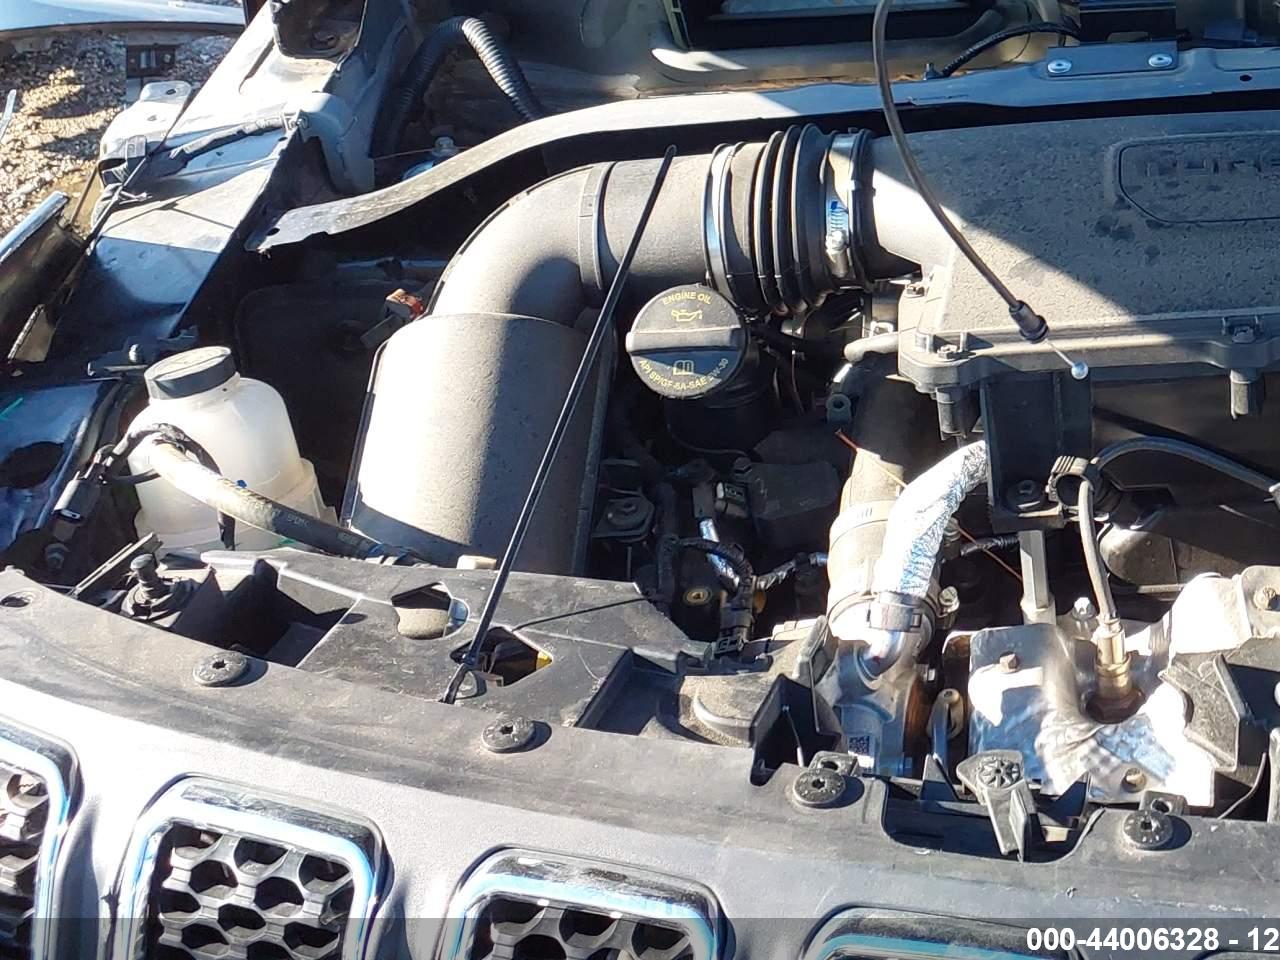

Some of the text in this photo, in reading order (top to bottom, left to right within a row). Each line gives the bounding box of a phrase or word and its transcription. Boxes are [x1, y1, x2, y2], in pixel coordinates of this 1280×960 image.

[662, 291, 713, 305] ENGINE OIL
[638, 359, 653, 375] API
